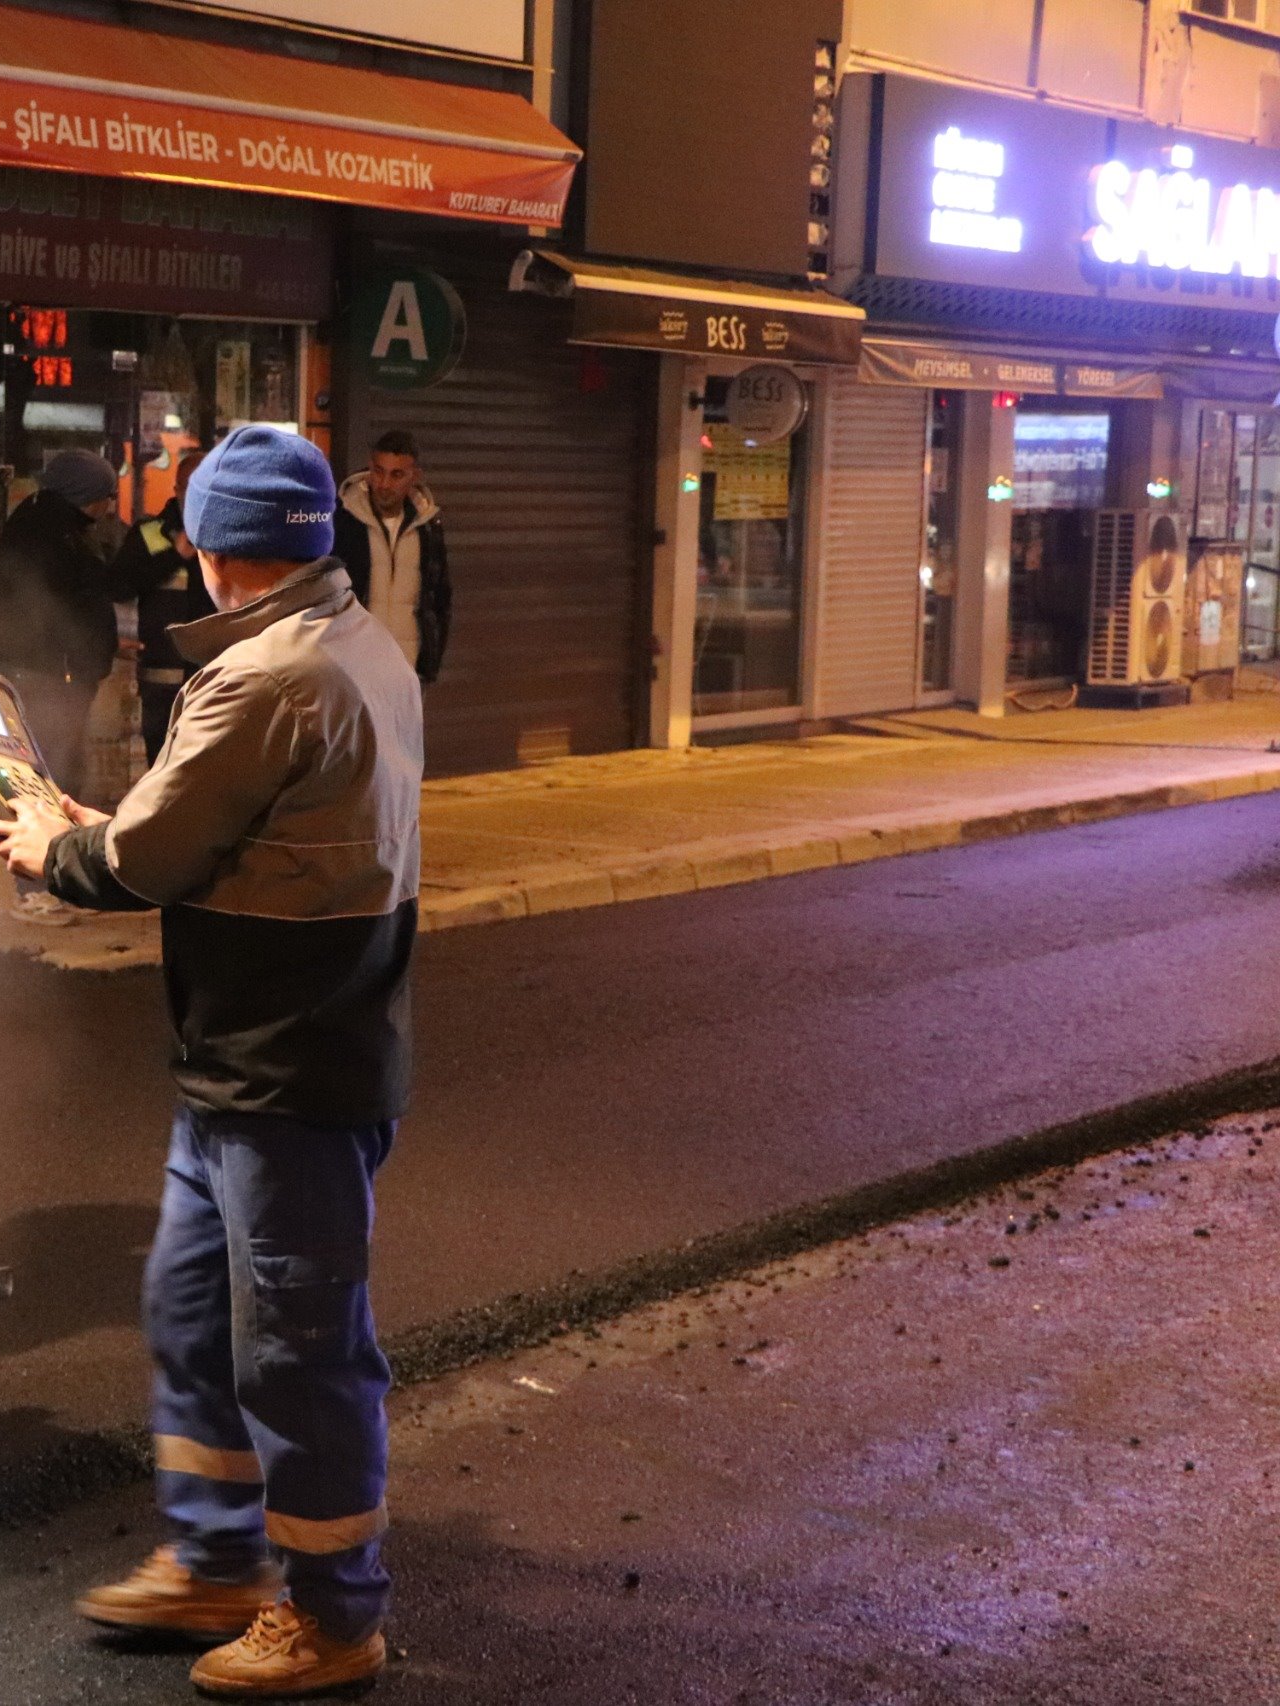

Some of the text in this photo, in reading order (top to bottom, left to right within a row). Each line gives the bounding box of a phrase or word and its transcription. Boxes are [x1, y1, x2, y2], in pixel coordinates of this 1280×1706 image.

[14, 100, 100, 150] ŞİFALI
[106, 112, 220, 163] BİTKLİER
[239, 136, 321, 176] DOĞAL
[325, 154, 435, 191] KOZMETİK
[448, 191, 509, 215] KUTLUBEY
[55, 244, 81, 280] ve
[371, 280, 429, 361] A
